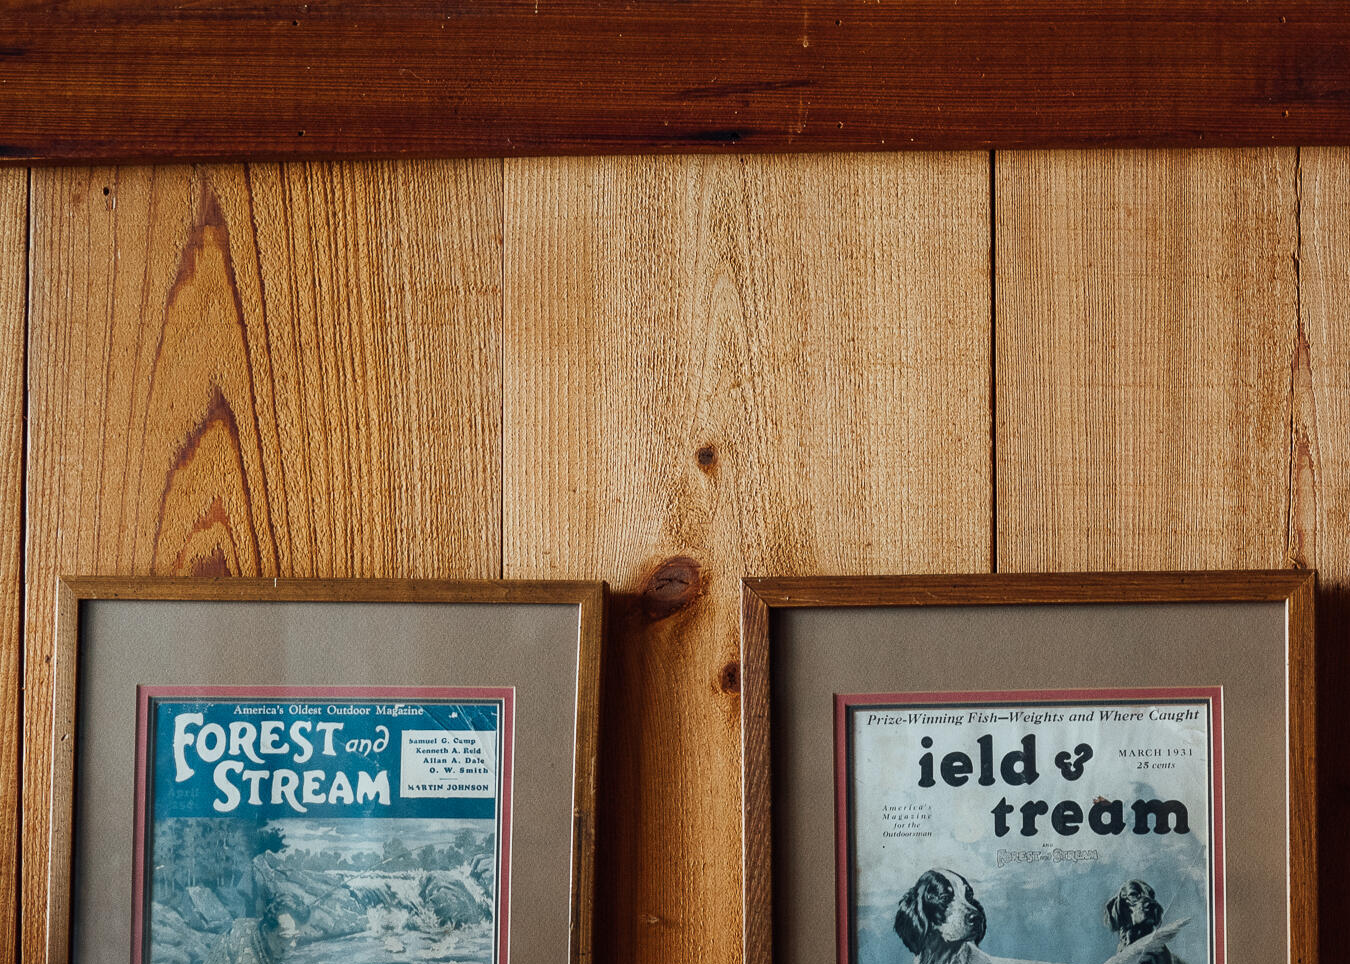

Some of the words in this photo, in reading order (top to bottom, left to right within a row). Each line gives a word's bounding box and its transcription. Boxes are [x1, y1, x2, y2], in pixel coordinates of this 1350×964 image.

[233, 705, 285, 716] America's
[288, 705, 322, 716] Oldest
[326, 705, 372, 716] Outdoor
[375, 705, 425, 718] Magazine
[867, 712, 965, 727] Prize-Winning
[1068, 710, 1095, 723] and
[1099, 710, 1144, 722] Where
[1148, 709, 1200, 724] Caught
[453, 738, 476, 746] Camp
[173, 713, 345, 782] FOREST
[345, 725, 390, 757] and
[1117, 748, 1163, 758] MARCH
[1166, 748, 1194, 757] 1931
[1054, 742, 1094, 781] &
[1135, 761, 1149, 770] 25
[1151, 761, 1176, 770] cents
[213, 760, 391, 813] STREAM
[882, 812, 933, 822] Magazine
[892, 821, 906, 830] for
[906, 821, 921, 829] the
[882, 830, 933, 838] Outdoorsman
